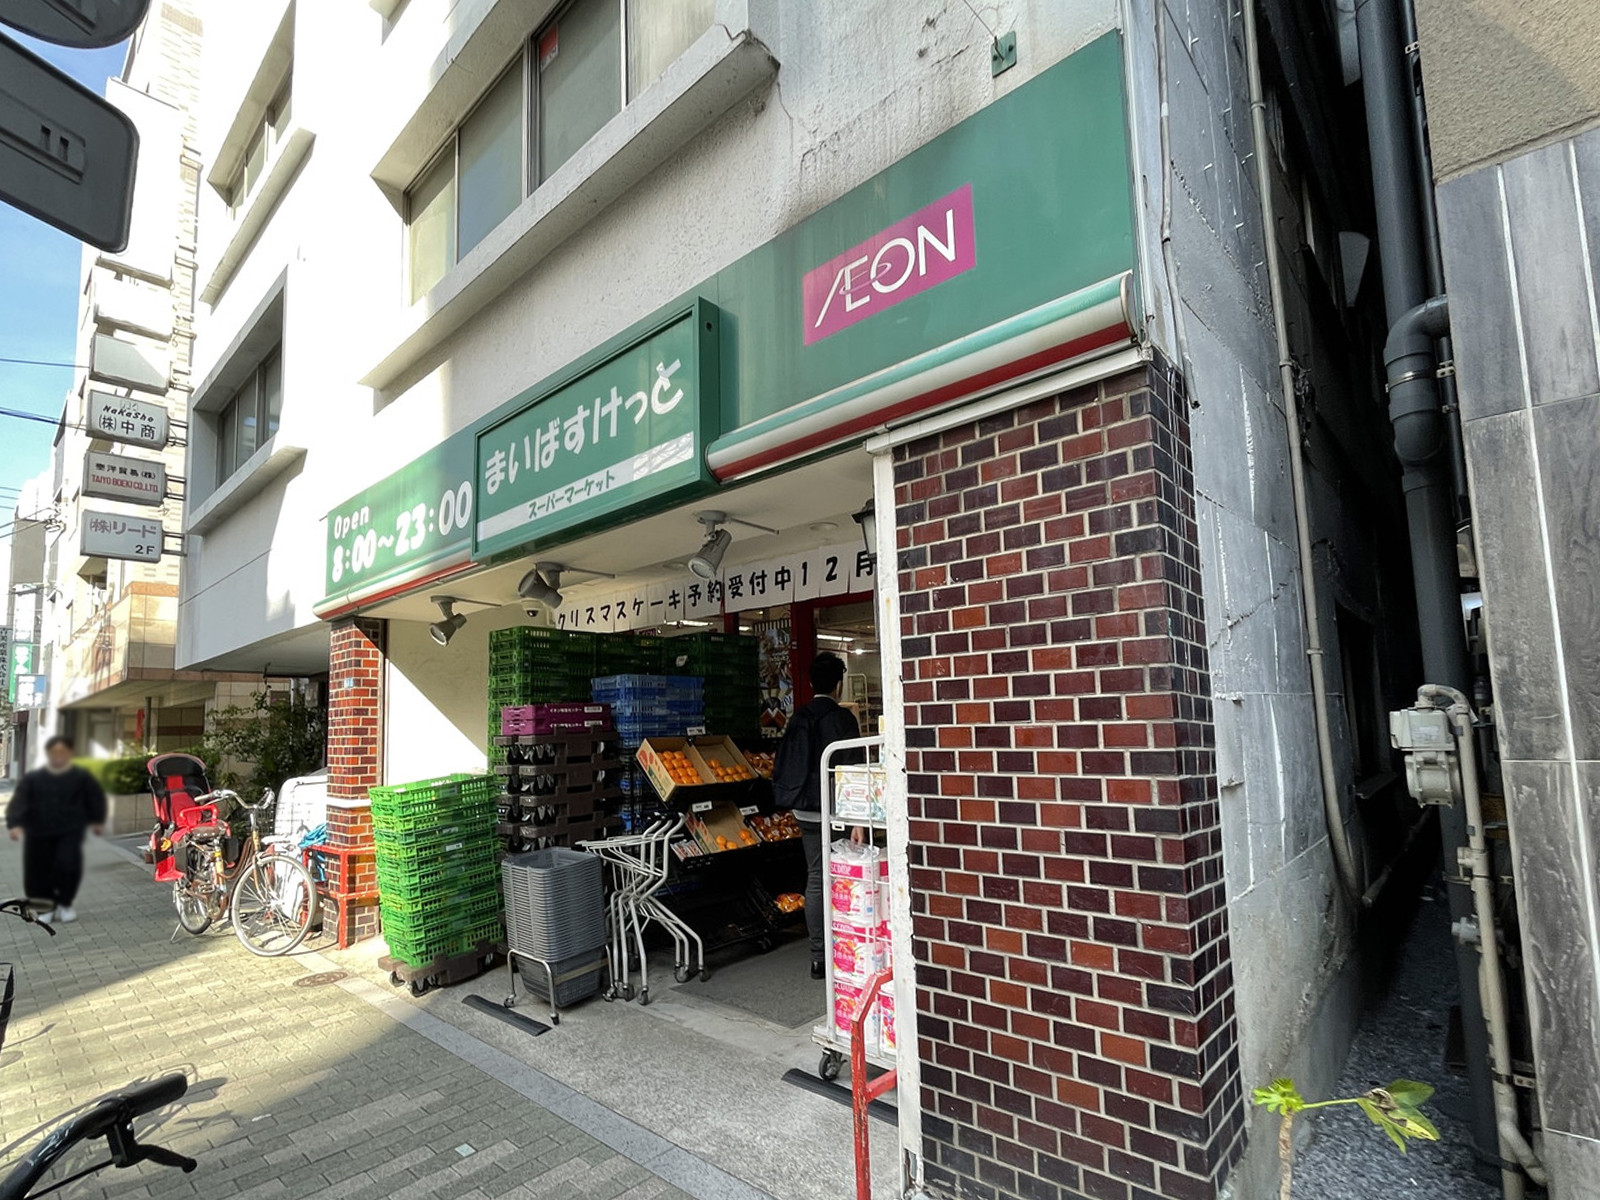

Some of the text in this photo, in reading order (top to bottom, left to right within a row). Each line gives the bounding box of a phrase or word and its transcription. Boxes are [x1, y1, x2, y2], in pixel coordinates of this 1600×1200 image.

[485, 359, 684, 495] まいばすけっと
[529, 469, 615, 519] スーパーマーケット
[334, 506, 369, 539] Open
[135, 544, 155, 555] 2F
